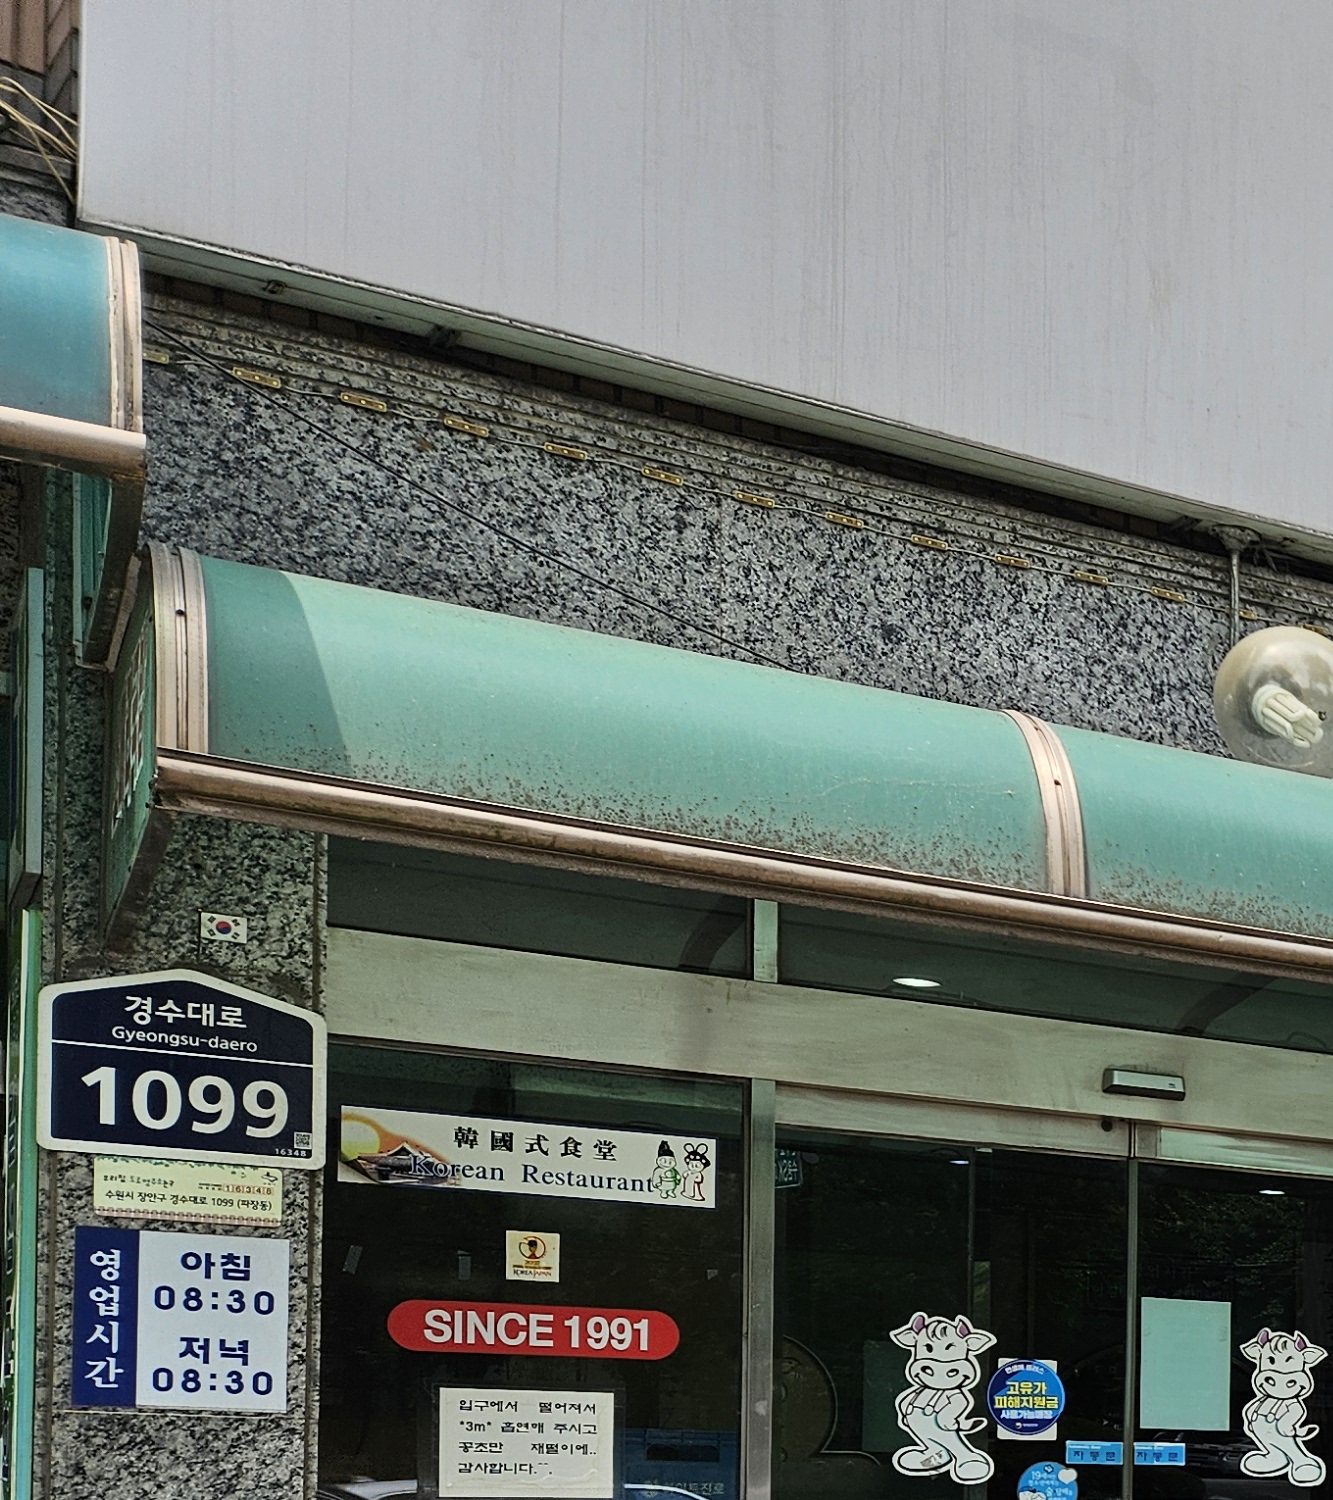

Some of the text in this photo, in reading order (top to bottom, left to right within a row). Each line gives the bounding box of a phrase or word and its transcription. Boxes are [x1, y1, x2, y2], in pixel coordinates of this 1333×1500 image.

[123, 995, 248, 1031] 경수대로
[110, 1025, 259, 1054] Gyeongsu-daero
[80, 1066, 290, 1140] 1099
[274, 1148, 308, 1158] 16348
[453, 1126, 618, 1163] 韓國式食堂
[410, 1153, 655, 1194] Korean Restaurant
[105, 1190, 273, 1212] 수원시 장안구 경수대로 1099 (파장동)
[181, 1250, 252, 1282] 아침
[152, 1286, 275, 1317] 08:30
[84, 1248, 125, 1389] 영업시간
[422, 1308, 651, 1352] SINCE 1991
[178, 1334, 250, 1366] 저녁
[151, 1367, 275, 1397] 08:30
[1006, 1381, 1047, 1396] 고유가
[459, 1400, 597, 1415] 입구에서 떨어져서
[993, 1396, 1059, 1409] 피해지원금
[553, 1423, 598, 1435] 주시고
